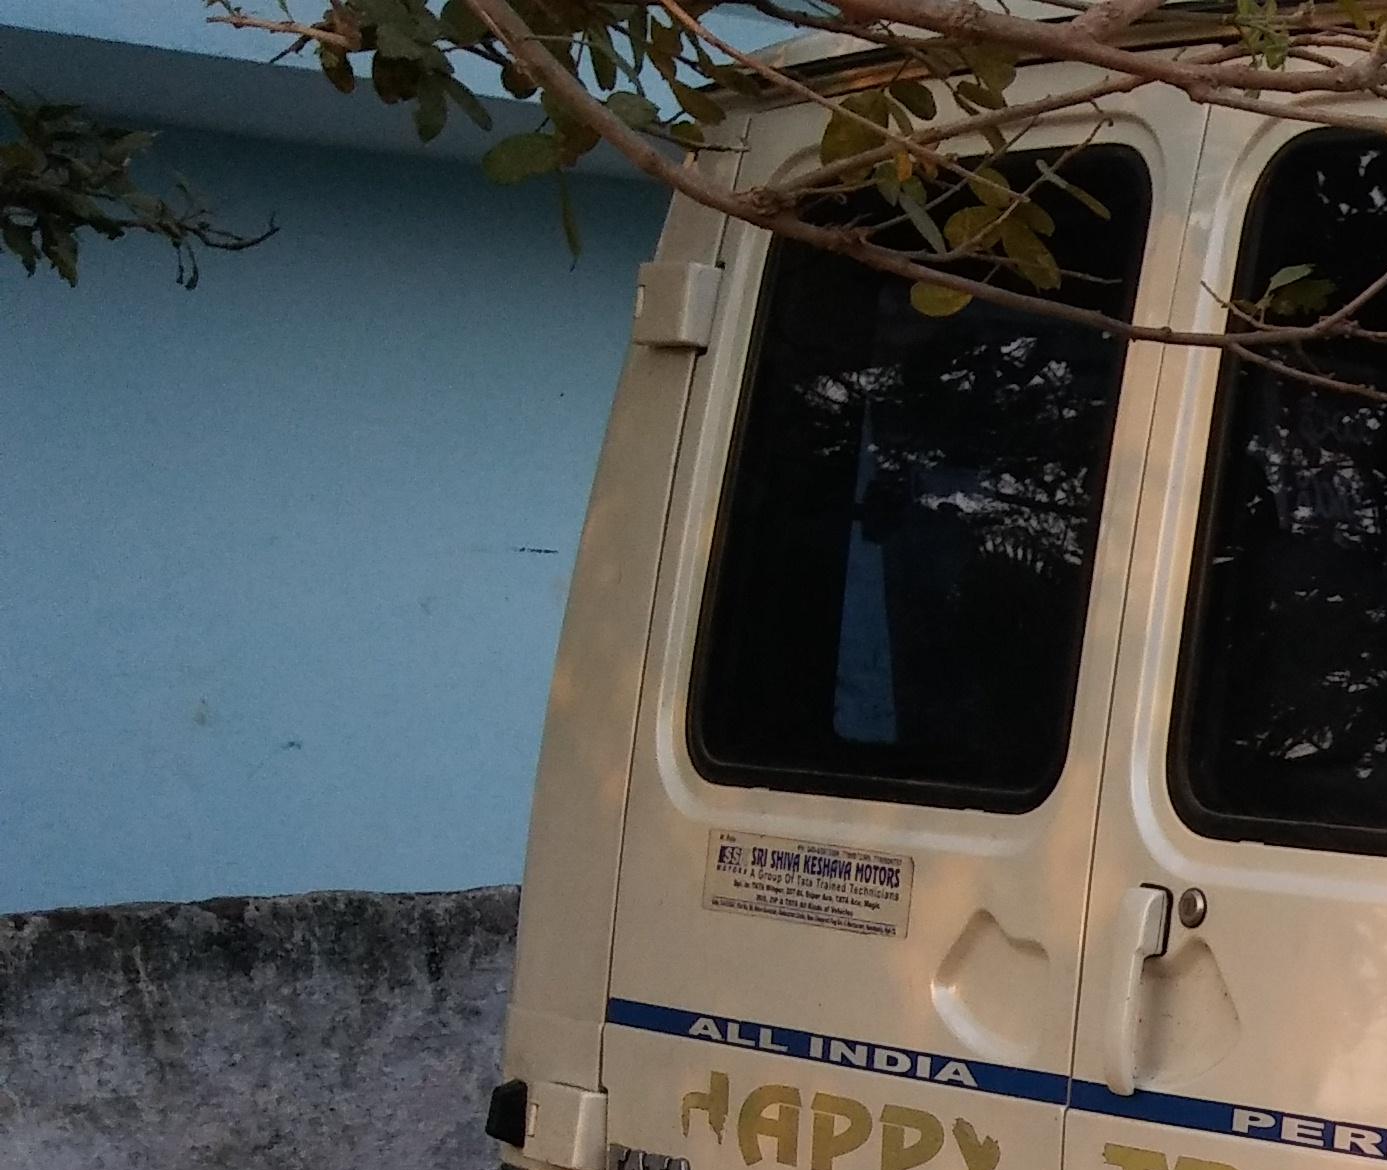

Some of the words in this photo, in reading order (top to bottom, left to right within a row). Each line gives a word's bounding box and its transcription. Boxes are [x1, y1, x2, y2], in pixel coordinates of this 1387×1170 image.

[750, 868, 756, 878] A
[758, 869, 782, 884] Group
[785, 872, 795, 884] Of
[797, 874, 813, 887] Tata
[816, 878, 847, 893] Trained
[849, 883, 900, 901] Technicians
[751, 846, 768, 867] SRI
[770, 849, 801, 873] SHIVA
[803, 854, 852, 882] KESHAVA
[855, 861, 900, 888] MOTORS
[688, 1016, 788, 1053] ALL
[809, 1035, 978, 1088] INDIA
